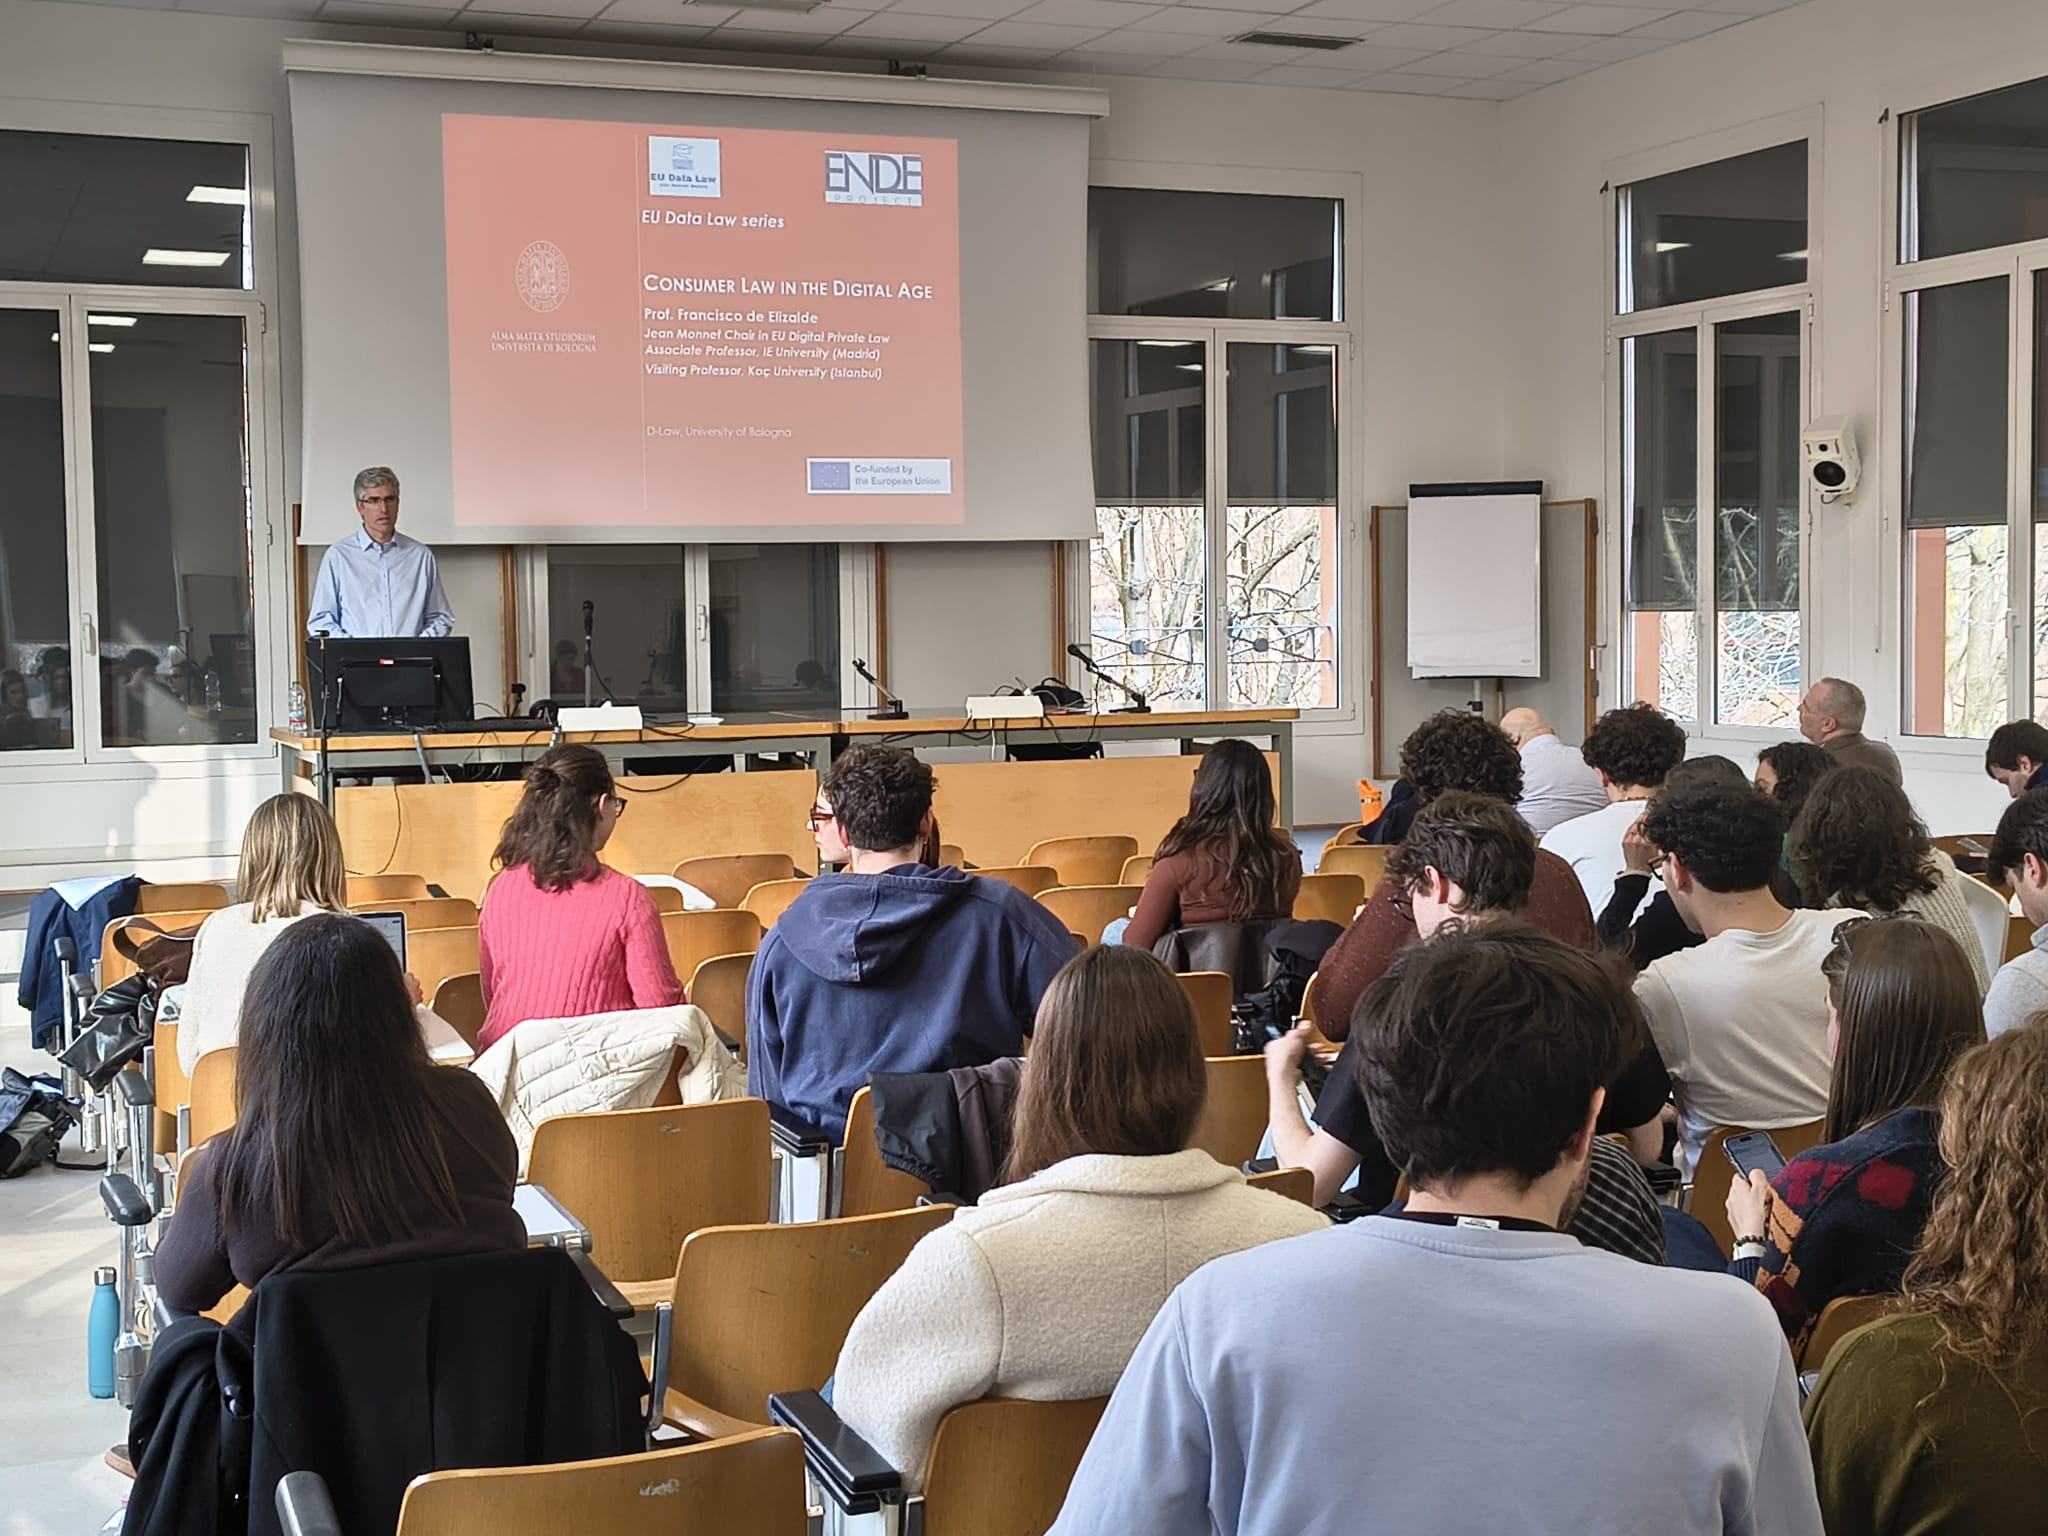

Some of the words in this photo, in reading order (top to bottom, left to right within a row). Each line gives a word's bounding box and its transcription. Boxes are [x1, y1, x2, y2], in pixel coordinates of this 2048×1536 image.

[650, 172, 665, 181] EU
[668, 173, 692, 183] Data
[695, 174, 717, 184] Law
[825, 152, 922, 195] ENDE
[642, 209, 660, 224] EU
[665, 210, 702, 225] Data
[707, 211, 737, 227] Law
[741, 213, 785, 228] series
[644, 308, 674, 321] Prof.
[677, 308, 742, 322] Francisco
[746, 310, 764, 322] de
[768, 311, 818, 323] Elizalde
[492, 331, 514, 341] ALMA
[516, 332, 544, 342] MATER
[545, 332, 597, 343] STUDIORUM
[643, 328, 673, 339] Jean
[676, 329, 721, 341] Monnet
[724, 329, 755, 341] Chair
[758, 330, 768, 341] in
[771, 330, 786, 342] EU
[788, 331, 825, 344] Digital
[827, 332, 866, 344] Private
[868, 333, 891, 344] Law
[543, 343, 554, 352] DI
[555, 343, 597, 353] BOLOGNA
[644, 344, 702, 355] Associate
[705, 345, 760, 357] Professor,
[775, 346, 829, 360] University
[832, 348, 881, 361] (Madrid)
[645, 364, 688, 377] Visiting
[690, 364, 745, 377] Professor,
[773, 365, 827, 380] University
[686, 426, 734, 438] University
[735, 427, 747, 437] of
[748, 427, 792, 439] Bologna
[854, 464, 900, 474] Co-funded
[902, 465, 913, 476] by
[855, 477, 869, 485] the
[871, 477, 913, 488] European
[914, 477, 941, 486] Union
